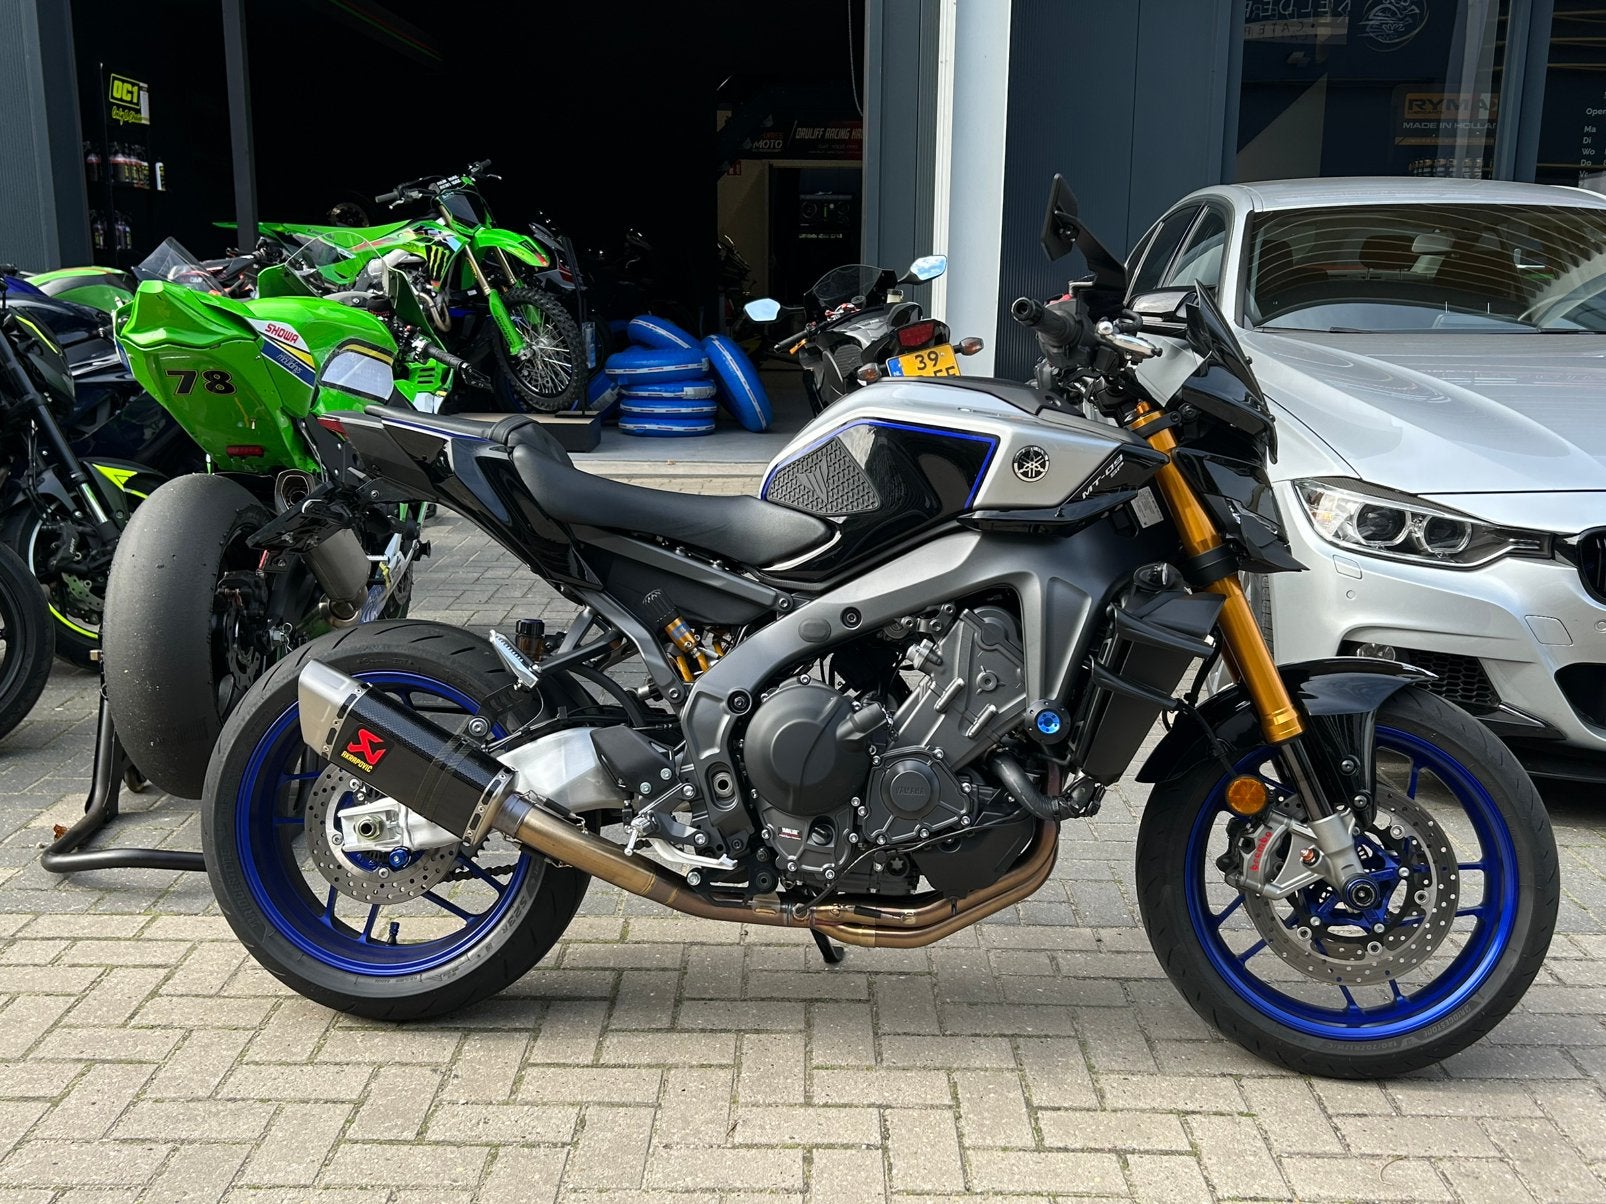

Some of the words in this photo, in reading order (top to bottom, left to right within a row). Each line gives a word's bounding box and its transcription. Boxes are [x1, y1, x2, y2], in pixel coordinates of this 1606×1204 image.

[112, 80, 138, 103] OC1
[1584, 125, 1597, 133] Ma
[752, 139, 783, 149] MOTO
[1583, 136, 1592, 144] Di
[1581, 148, 1596, 156] Wo
[1580, 159, 1592, 167] Do
[264, 322, 300, 344] SHOWA
[914, 350, 939, 371] 39
[164, 368, 237, 395] 78
[1081, 453, 1124, 500] MT-09
[1110, 460, 1125, 478] SP
[1250, 831, 1273, 872] brembo
